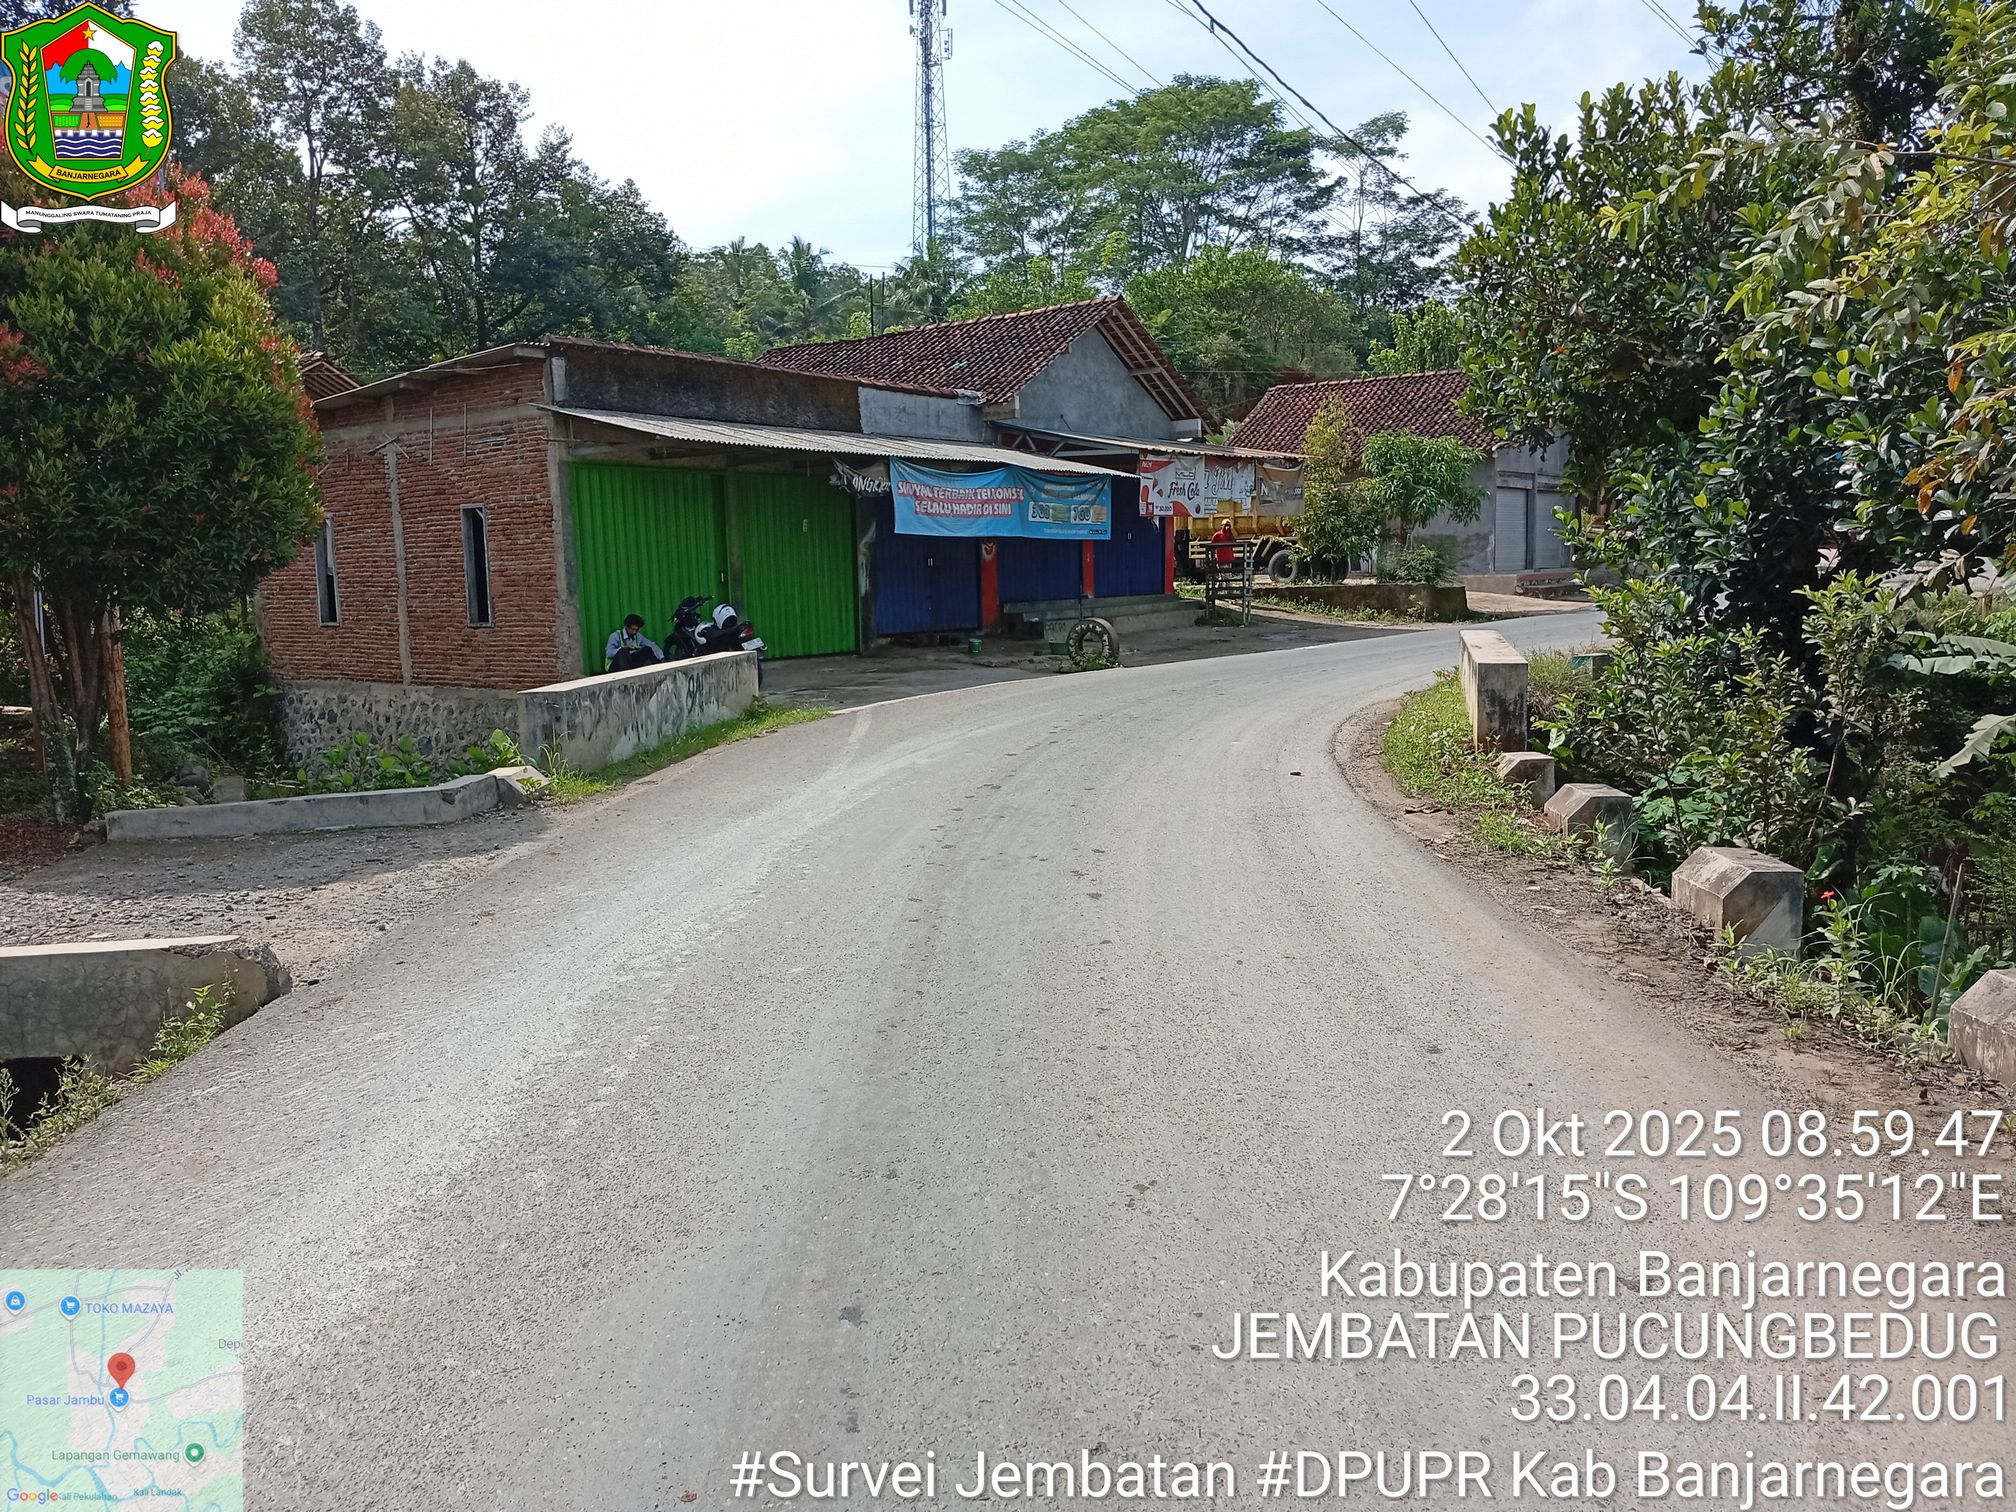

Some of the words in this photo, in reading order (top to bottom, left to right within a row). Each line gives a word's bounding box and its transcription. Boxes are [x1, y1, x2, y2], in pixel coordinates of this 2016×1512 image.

[897, 481, 932, 499] SINYAL
[932, 486, 976, 500] TERBAIK
[977, 488, 1025, 500] TELKOMSEL
[1167, 481, 1187, 499] Fresh
[1187, 481, 1201, 501] Cola
[915, 501, 953, 514] SELALU
[953, 502, 983, 515] HADIR
[983, 503, 993, 515] DI
[993, 503, 1012, 515] SINI
